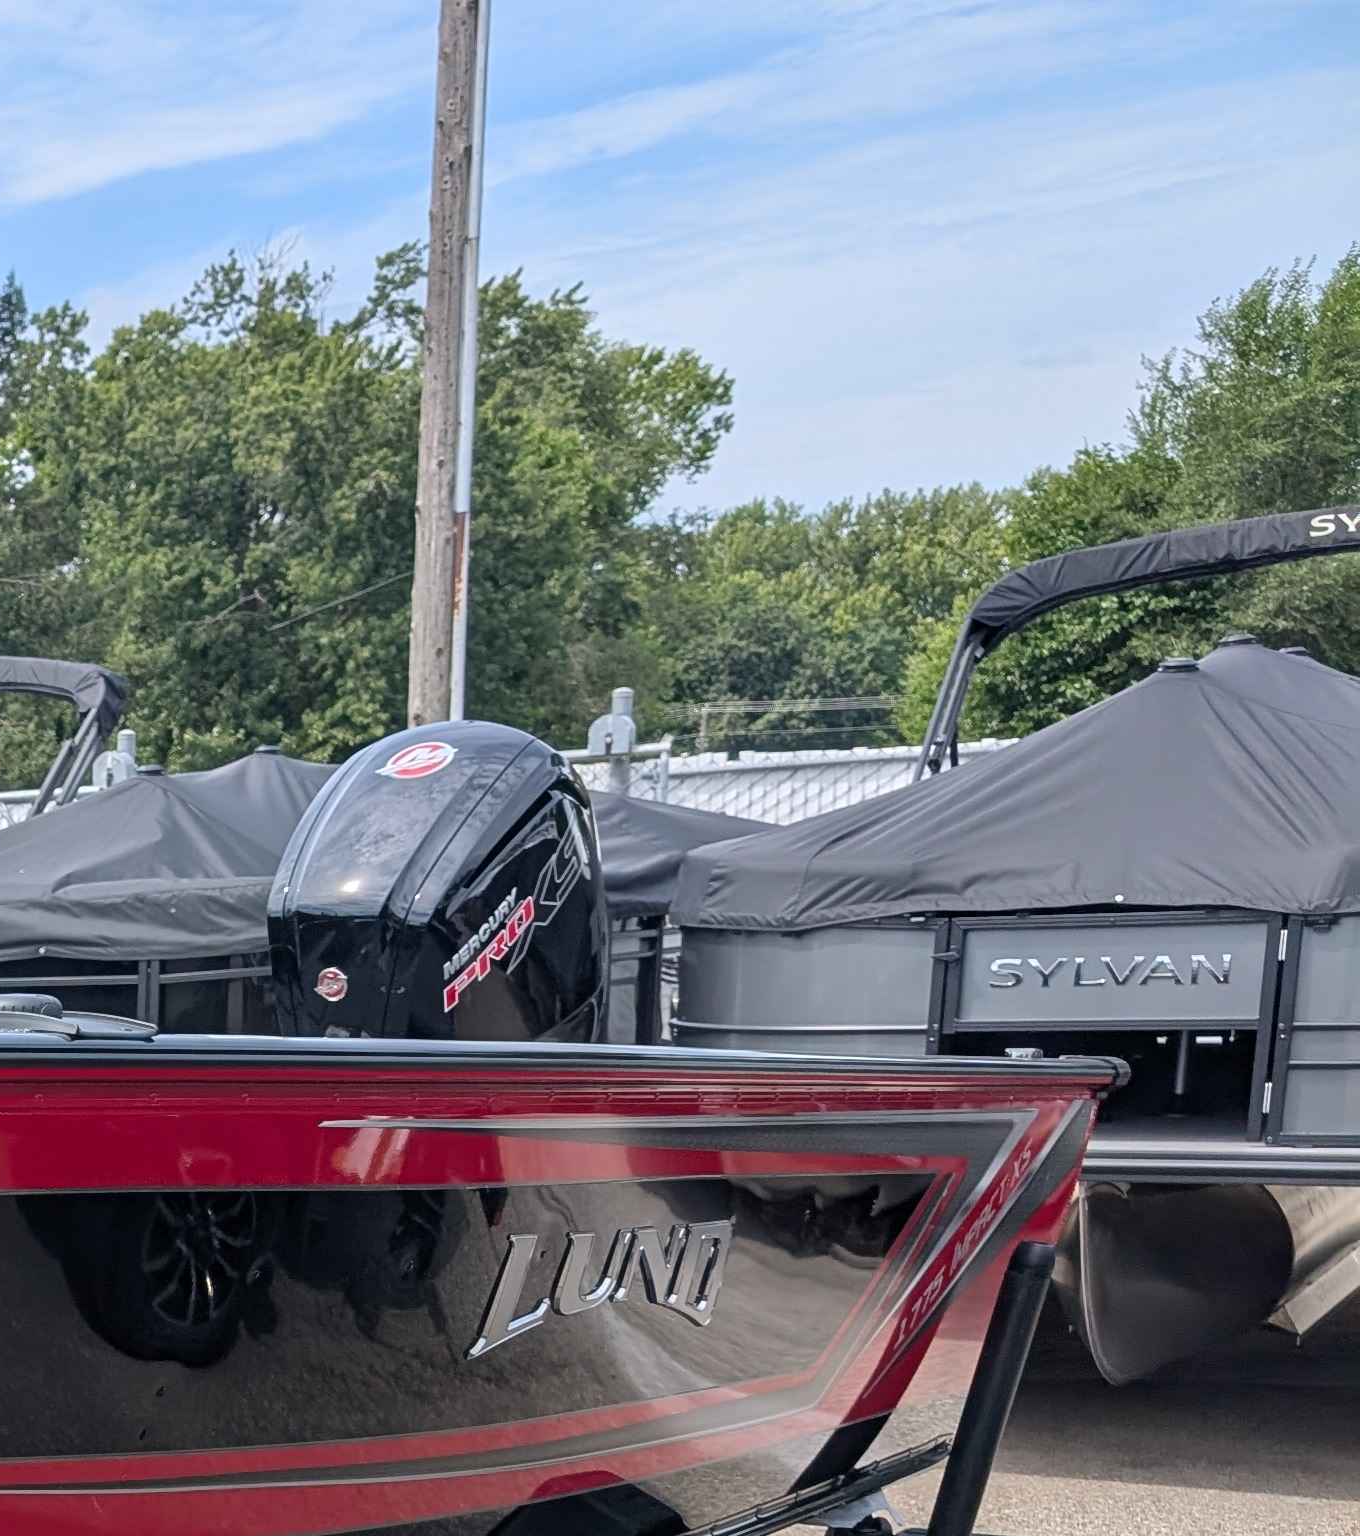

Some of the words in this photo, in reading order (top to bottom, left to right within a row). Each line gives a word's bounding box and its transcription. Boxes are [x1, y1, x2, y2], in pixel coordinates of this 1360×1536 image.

[443, 886, 519, 981] MERCURY
[443, 896, 535, 1014] PRO
[988, 952, 1233, 989] SYLVAN
[463, 1216, 737, 1361] LUND
